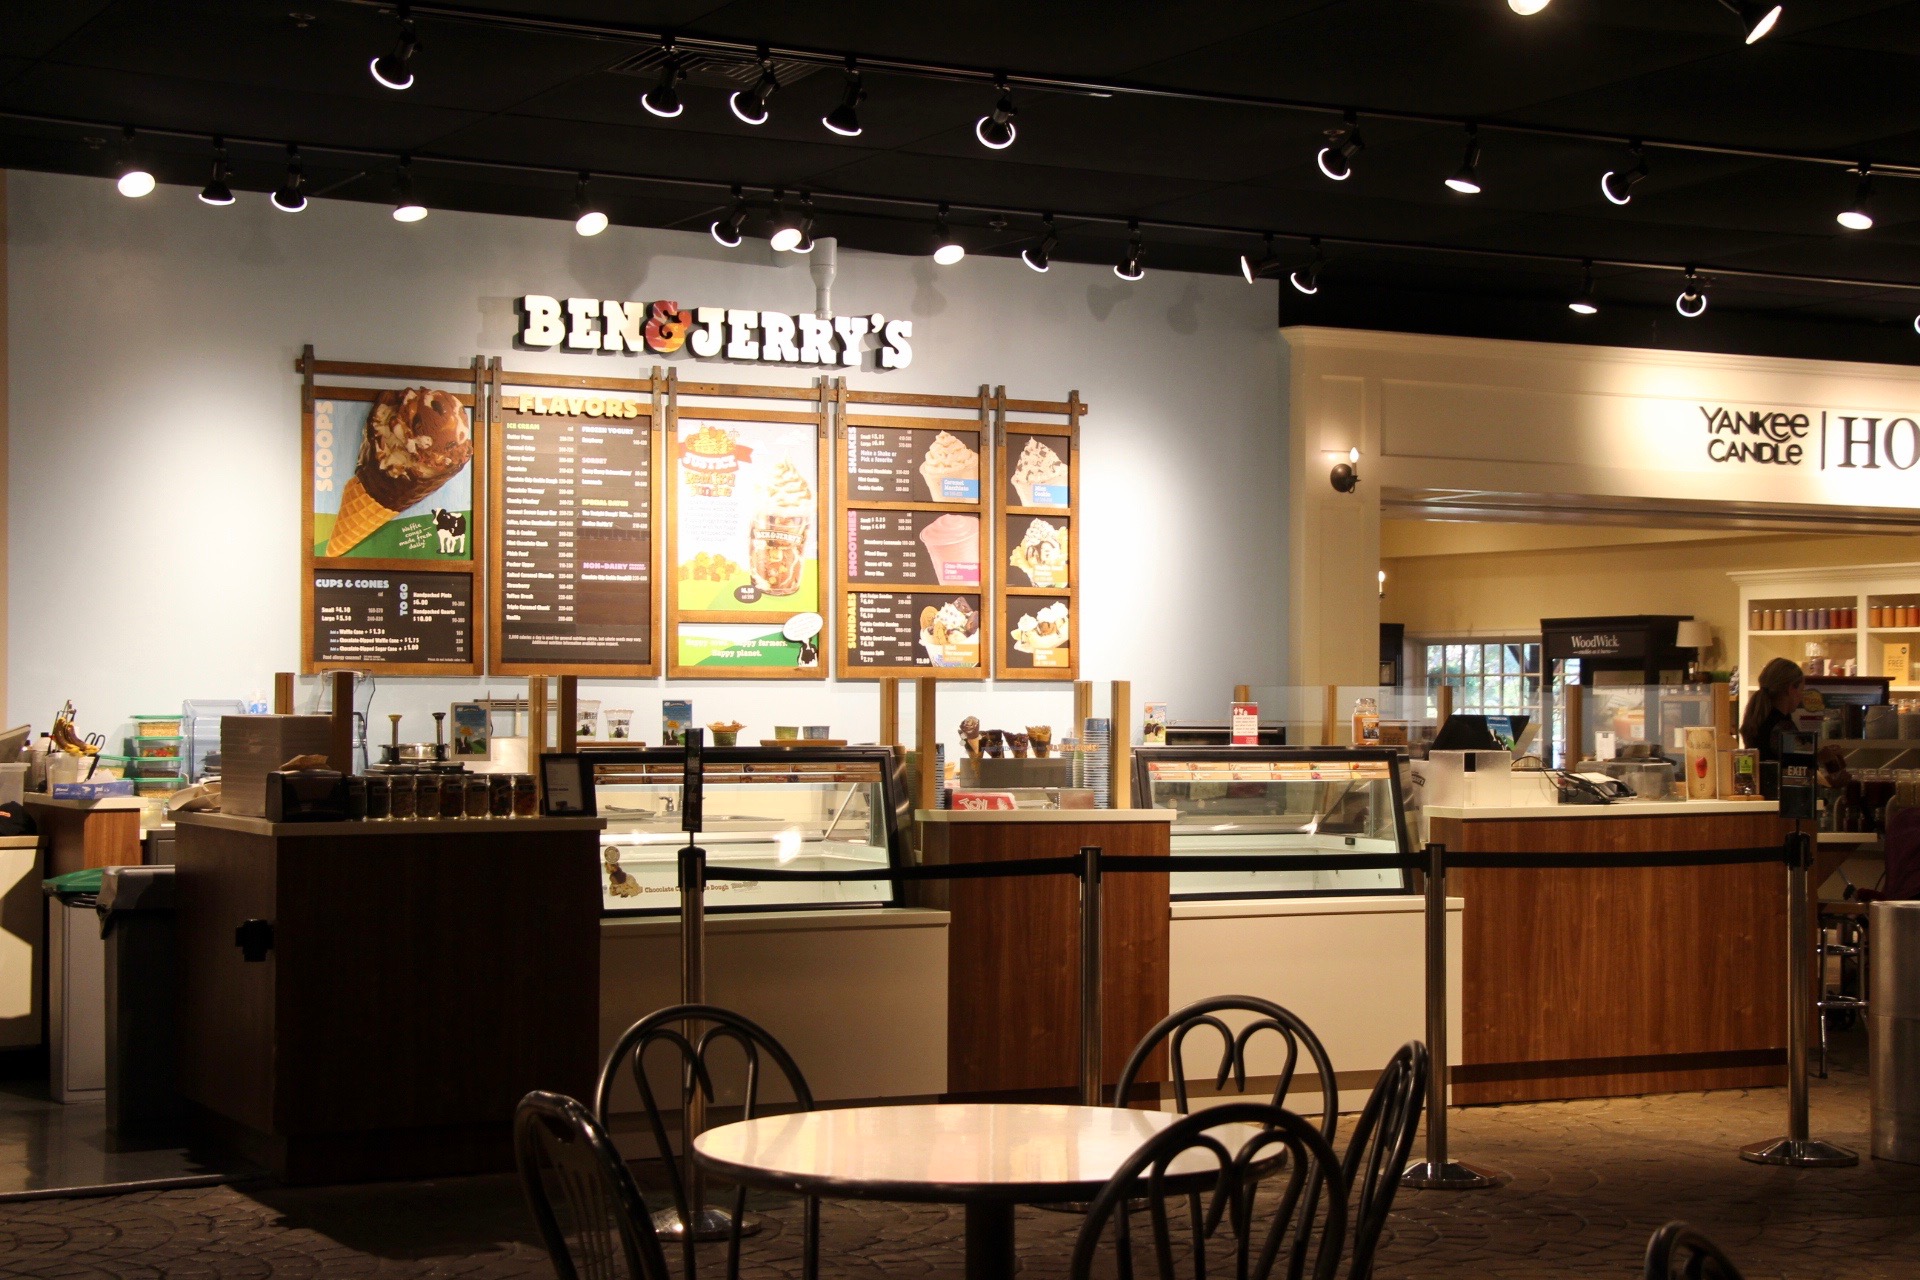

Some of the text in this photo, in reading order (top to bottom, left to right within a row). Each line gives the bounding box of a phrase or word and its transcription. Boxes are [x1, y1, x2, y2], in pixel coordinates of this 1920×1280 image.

[524, 294, 912, 368] BEN & JERRY'S
[520, 394, 638, 418] FLAVORS
[316, 401, 333, 492] SCOOPS
[848, 427, 856, 473] SHAKES
[399, 532, 432, 546] made fresh
[402, 522, 422, 533] Waffle
[405, 530, 422, 538] cones
[848, 511, 857, 576] SMOOTHIES
[316, 579, 343, 588] CUPS
[355, 580, 389, 588] CONES
[400, 583, 408, 616] TO GO
[848, 593, 856, 649] SUNDAES
[1571, 635, 1619, 647] WoodWick
[1787, 766, 1808, 776] EXIT
